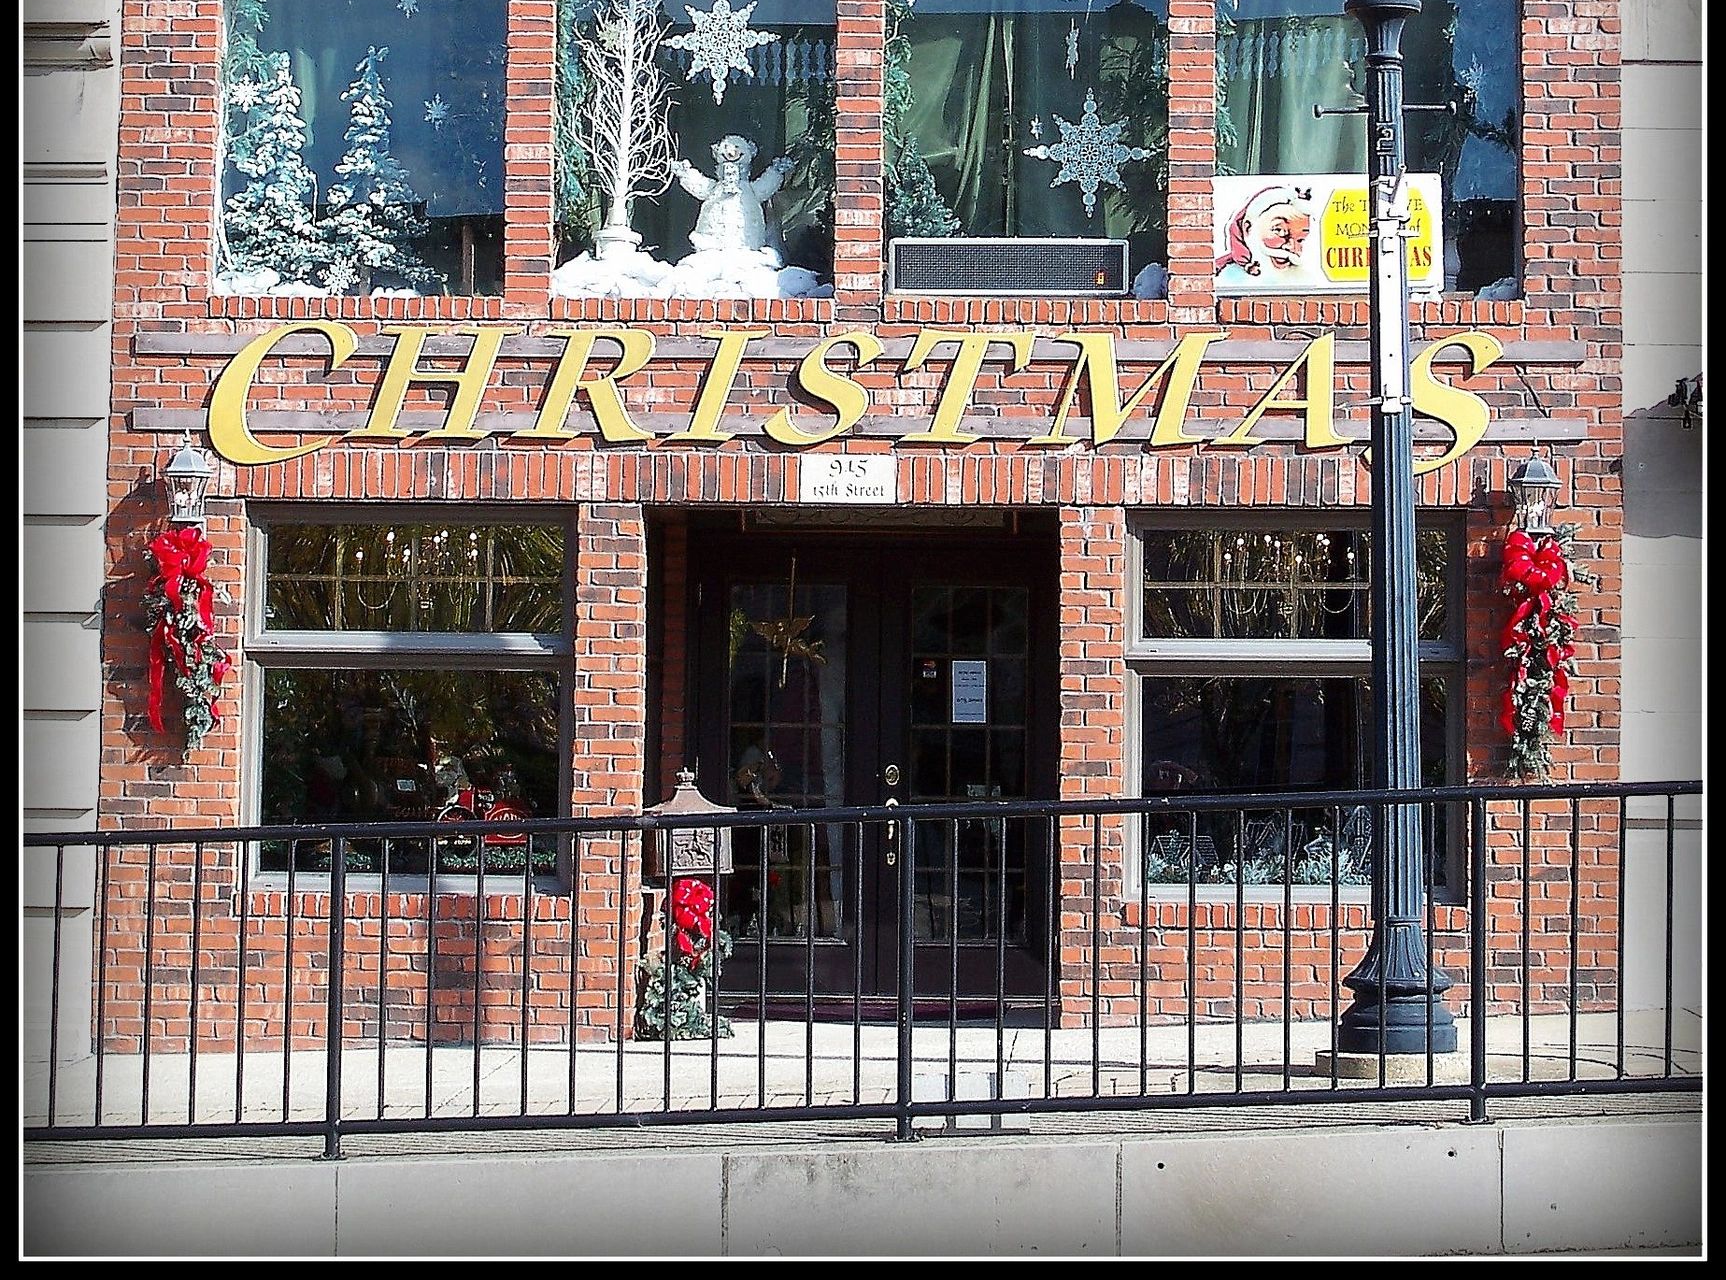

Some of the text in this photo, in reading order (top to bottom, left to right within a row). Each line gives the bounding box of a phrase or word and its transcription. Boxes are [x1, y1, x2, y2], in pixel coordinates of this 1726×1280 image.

[1332, 196, 1355, 213] The
[1326, 245, 1432, 268] CHRIAS
[203, 320, 1505, 474] CHRISTMAS
[845, 482, 884, 497] Street
